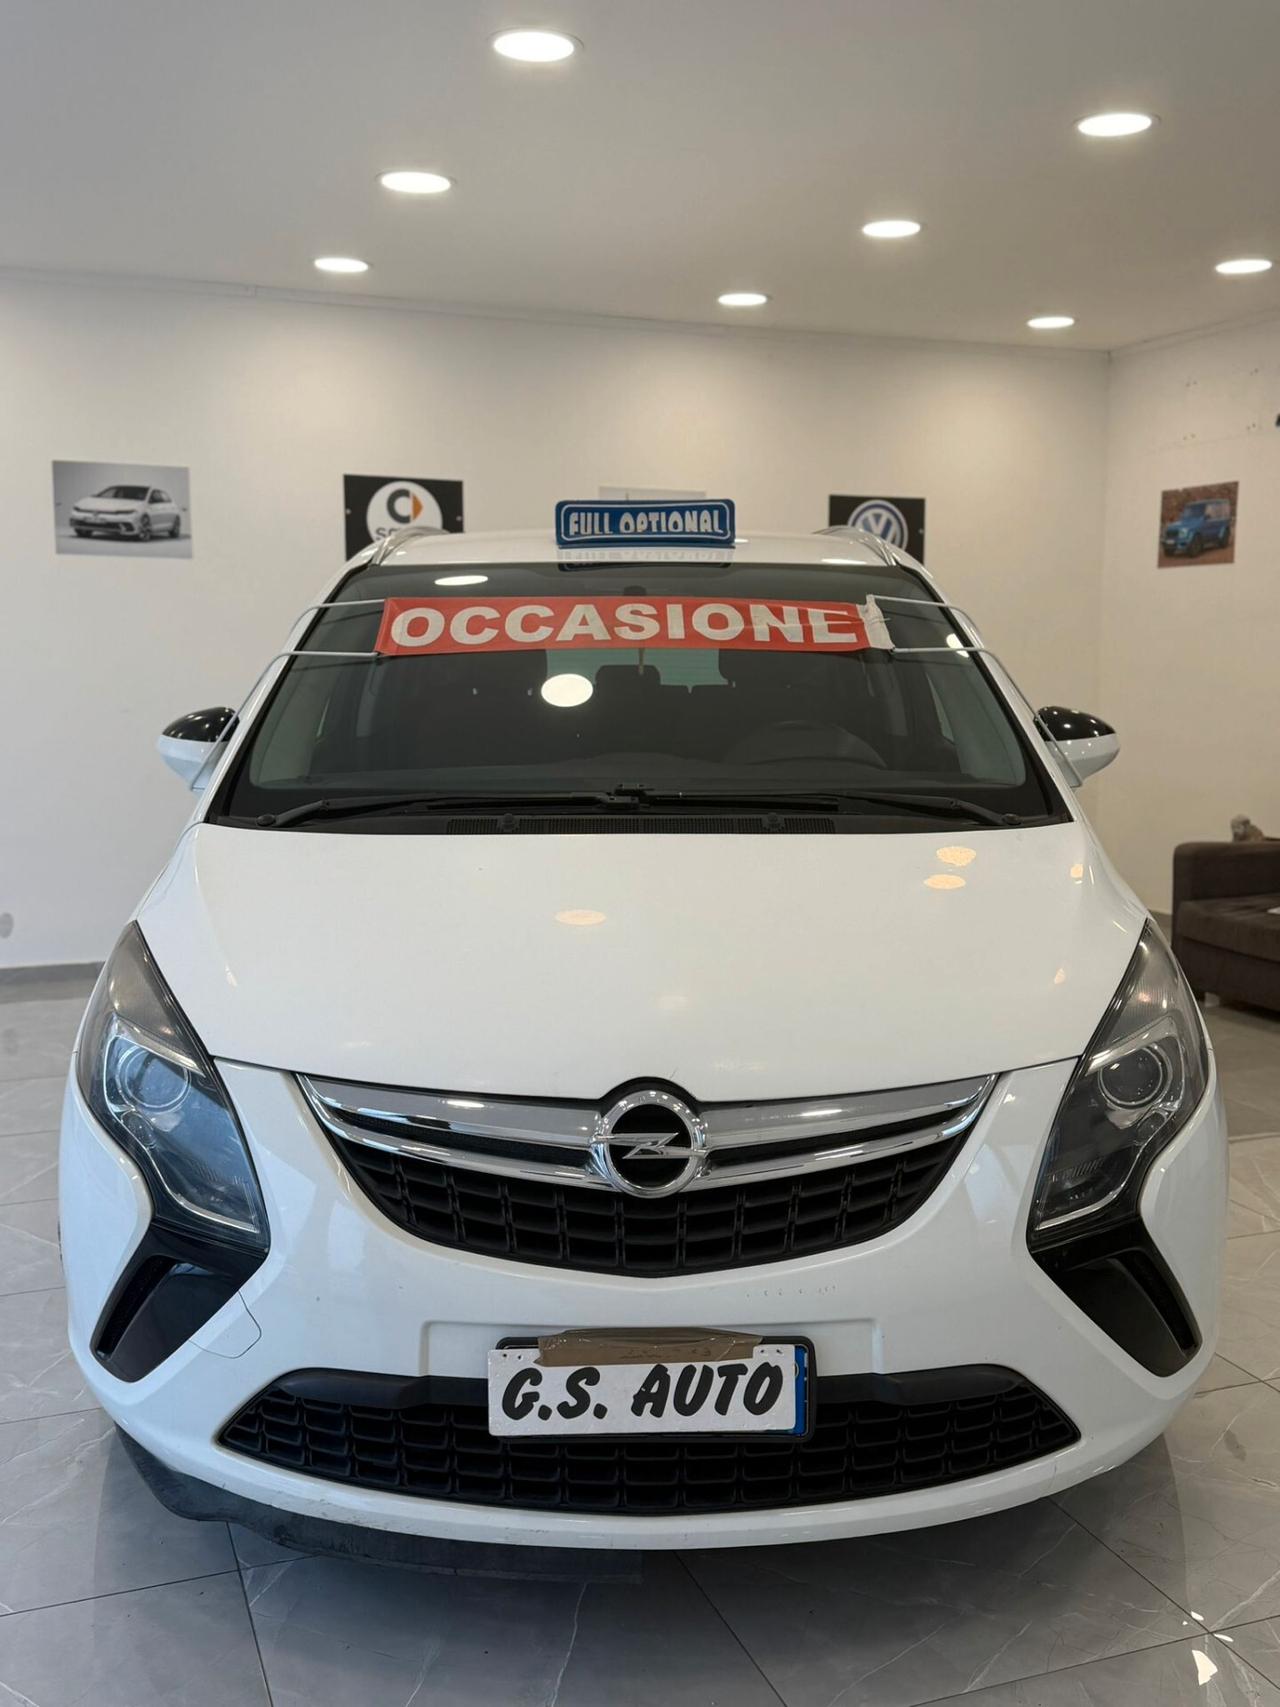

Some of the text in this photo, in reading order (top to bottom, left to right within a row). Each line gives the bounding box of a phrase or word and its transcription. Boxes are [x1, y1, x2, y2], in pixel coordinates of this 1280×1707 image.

[569, 509, 724, 536] FULL OPTIONAL
[390, 602, 858, 648] OCCASIONE
[502, 1361, 784, 1421] G.S. AUTO
